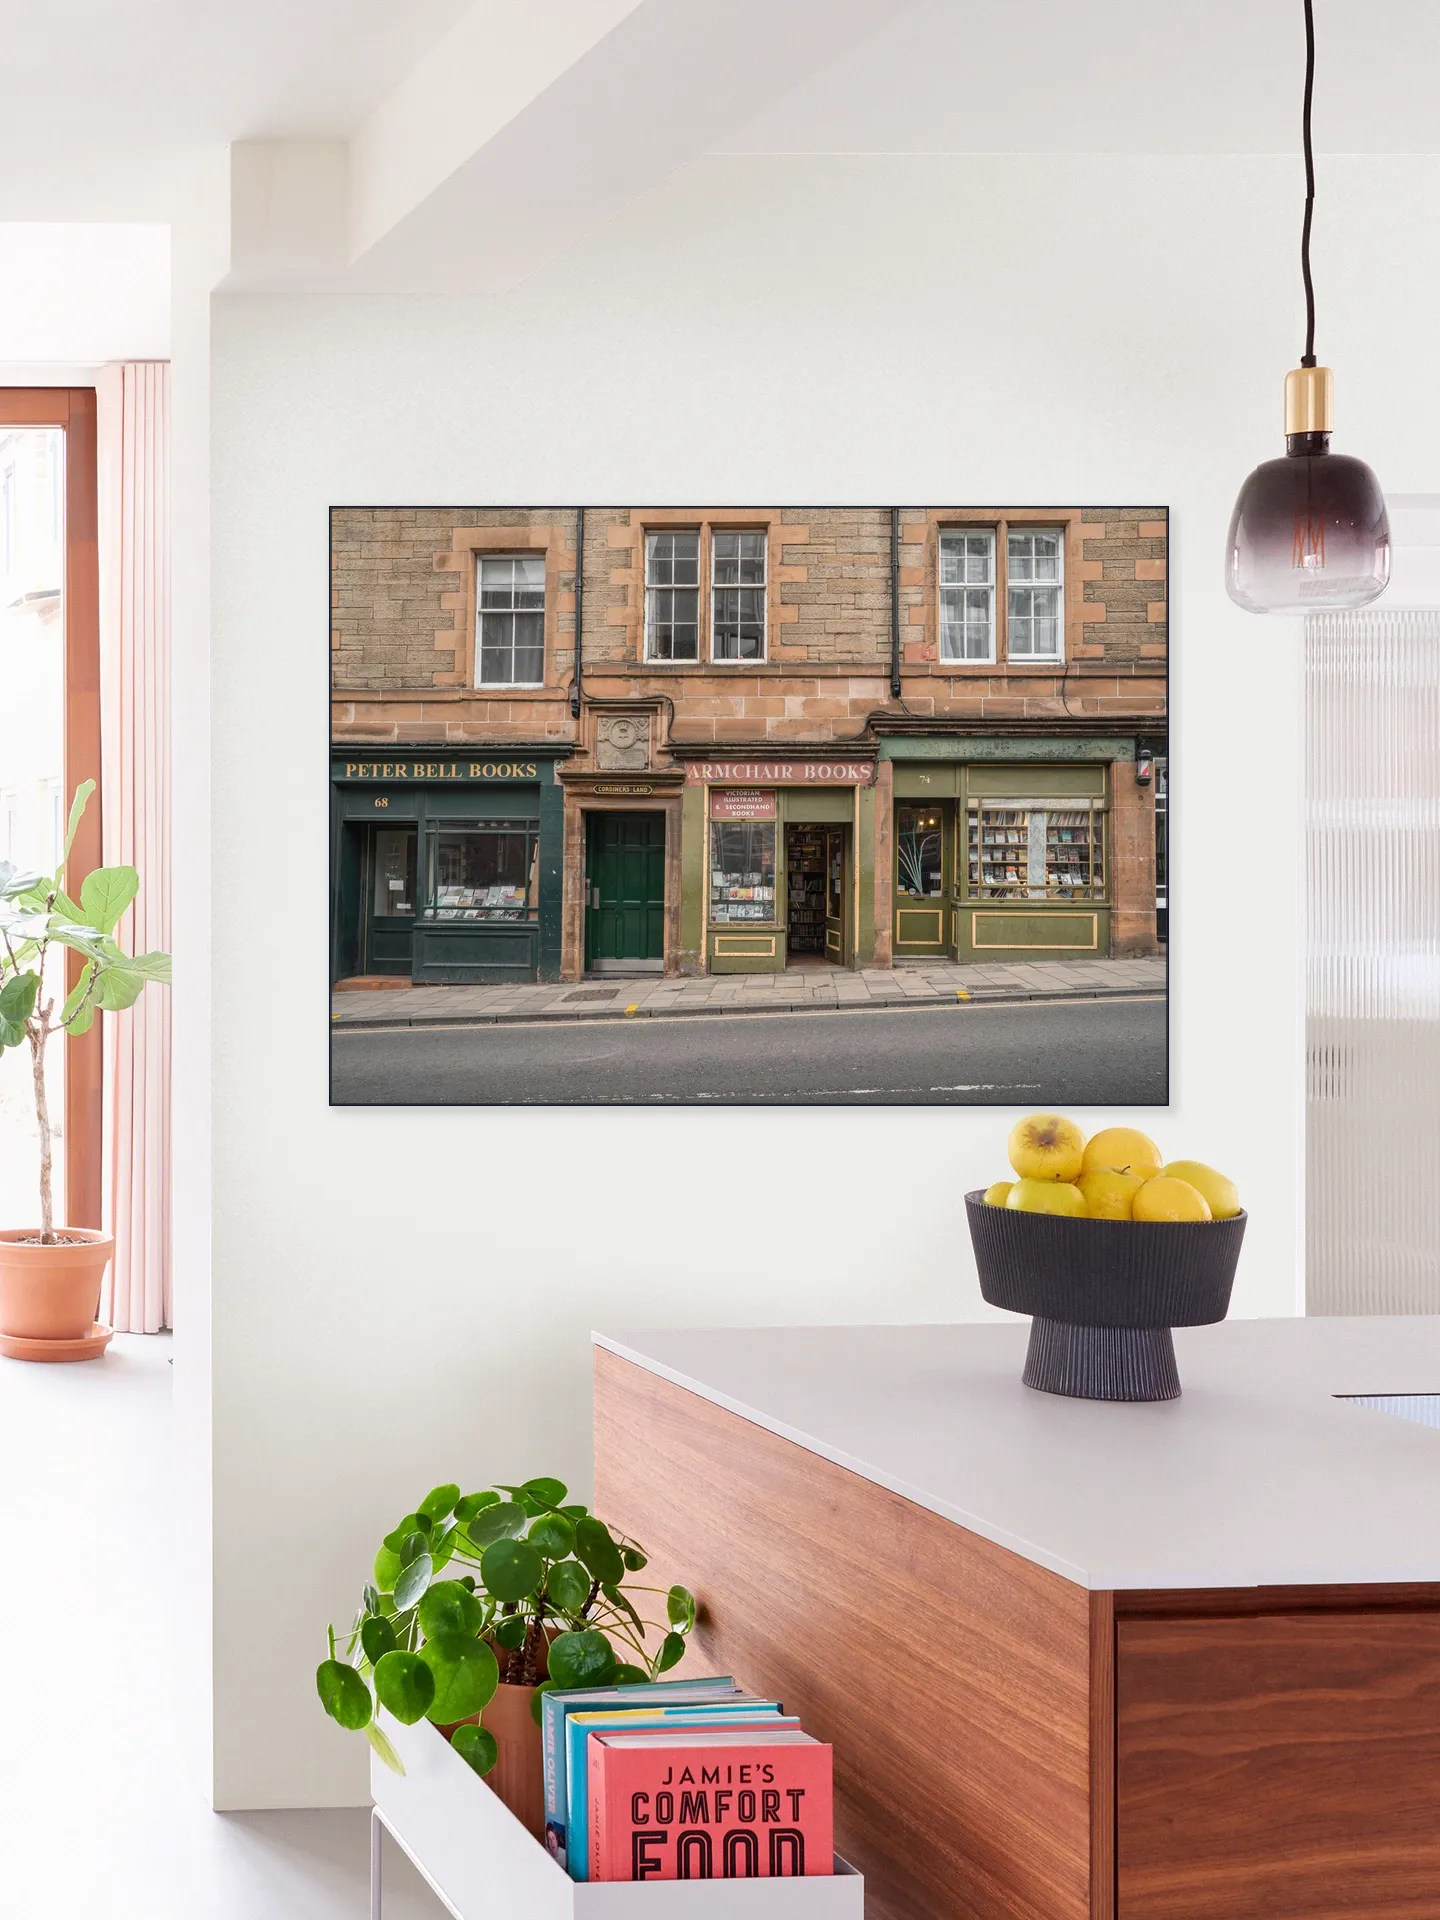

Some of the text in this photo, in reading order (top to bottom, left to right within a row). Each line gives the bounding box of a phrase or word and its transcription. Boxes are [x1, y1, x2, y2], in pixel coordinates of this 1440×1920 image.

[345, 763, 537, 778] PETER BELL BOOKS
[687, 764, 872, 779] ARMCHAIR BOOKS
[919, 773, 932, 784] 74
[374, 797, 389, 808] 68
[546, 1705, 556, 1814] JAMIE OLIVER
[661, 1764, 775, 1785] JAMIE'S
[631, 1788, 806, 1825] COMFORT
[631, 1828, 806, 1881] FOOD
